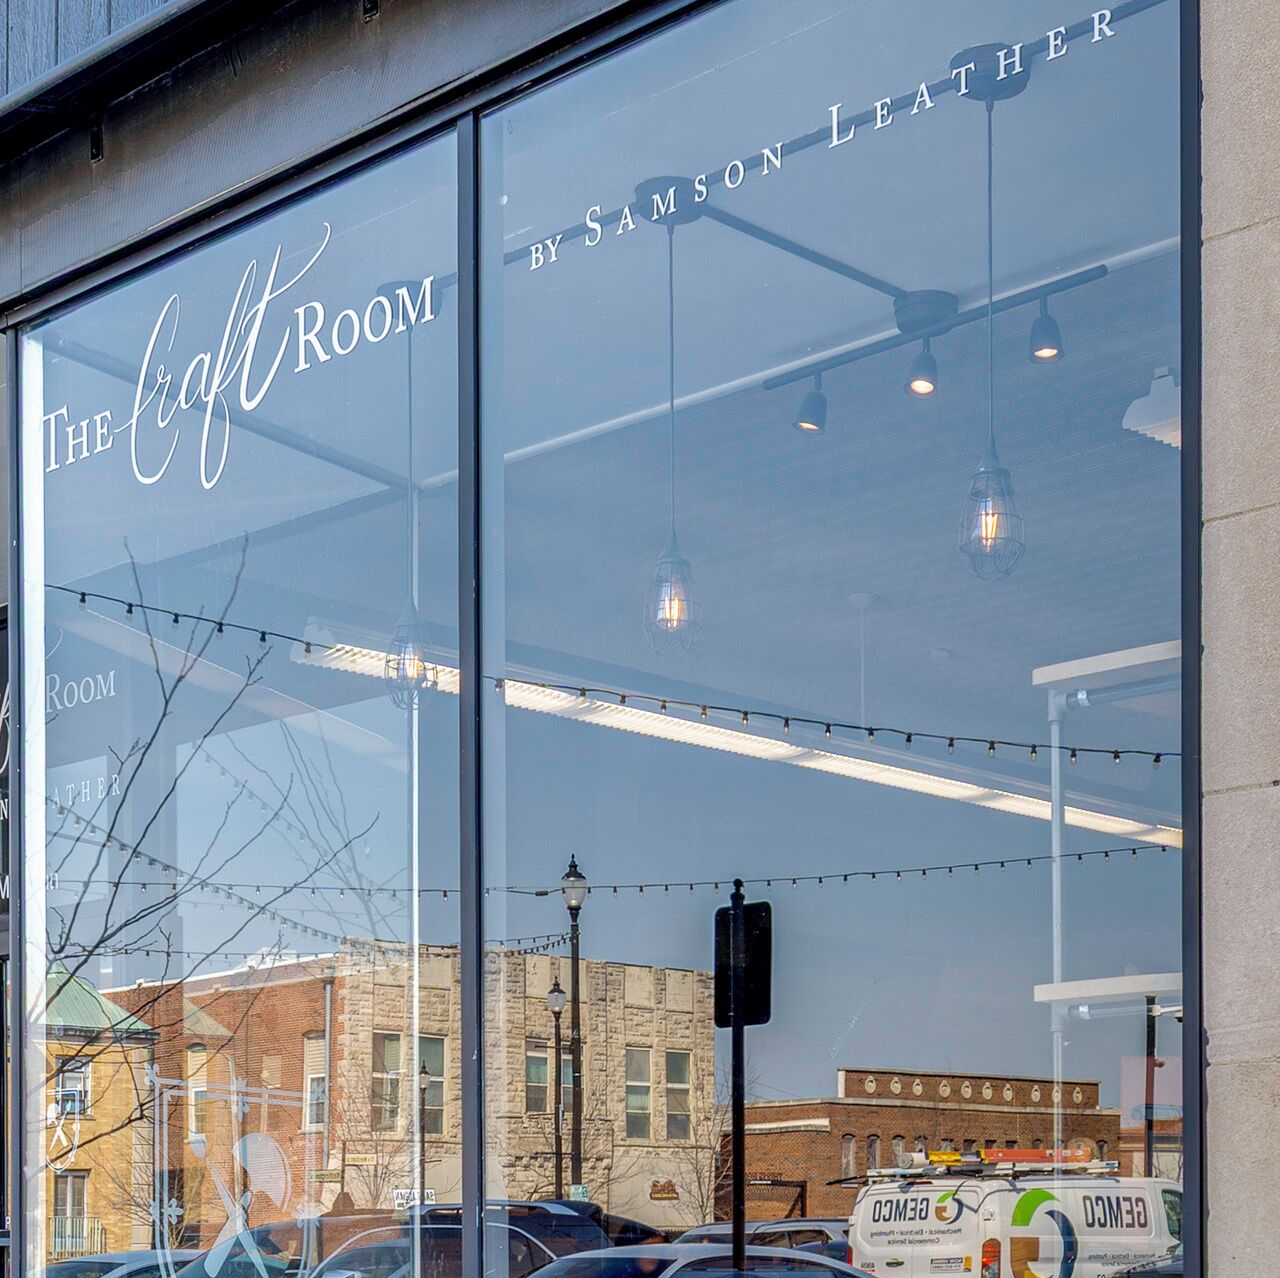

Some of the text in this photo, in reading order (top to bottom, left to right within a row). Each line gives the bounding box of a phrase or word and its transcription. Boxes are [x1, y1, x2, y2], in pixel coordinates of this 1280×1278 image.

[529, 8, 1116, 271] BY SAMSON LEATHER
[42, 221, 436, 490] THE Craft ROOM
[45, 669, 116, 713] ROOM
[51, 773, 121, 808] ATHER
